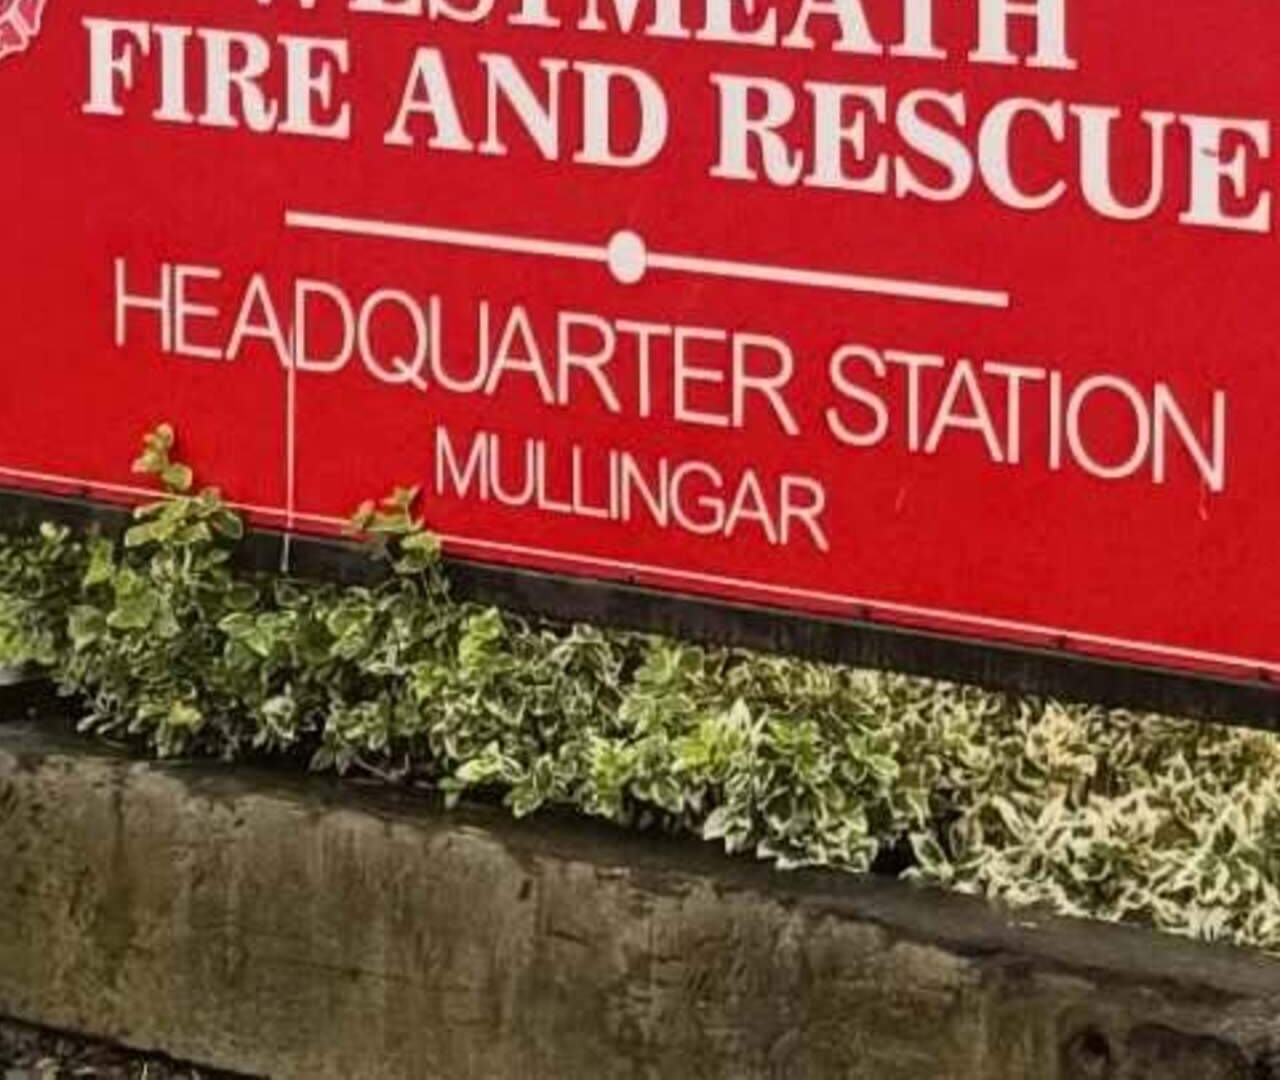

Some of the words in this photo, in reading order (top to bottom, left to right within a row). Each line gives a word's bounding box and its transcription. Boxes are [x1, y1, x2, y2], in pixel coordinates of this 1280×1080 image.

[81, 17, 350, 139] FIRE
[383, 47, 669, 167] AND
[710, 73, 1271, 232] RESCUE
[115, 258, 799, 435] HEADQUARTER
[825, 345, 1226, 492] STATION
[436, 427, 828, 550] MULLINGAR
